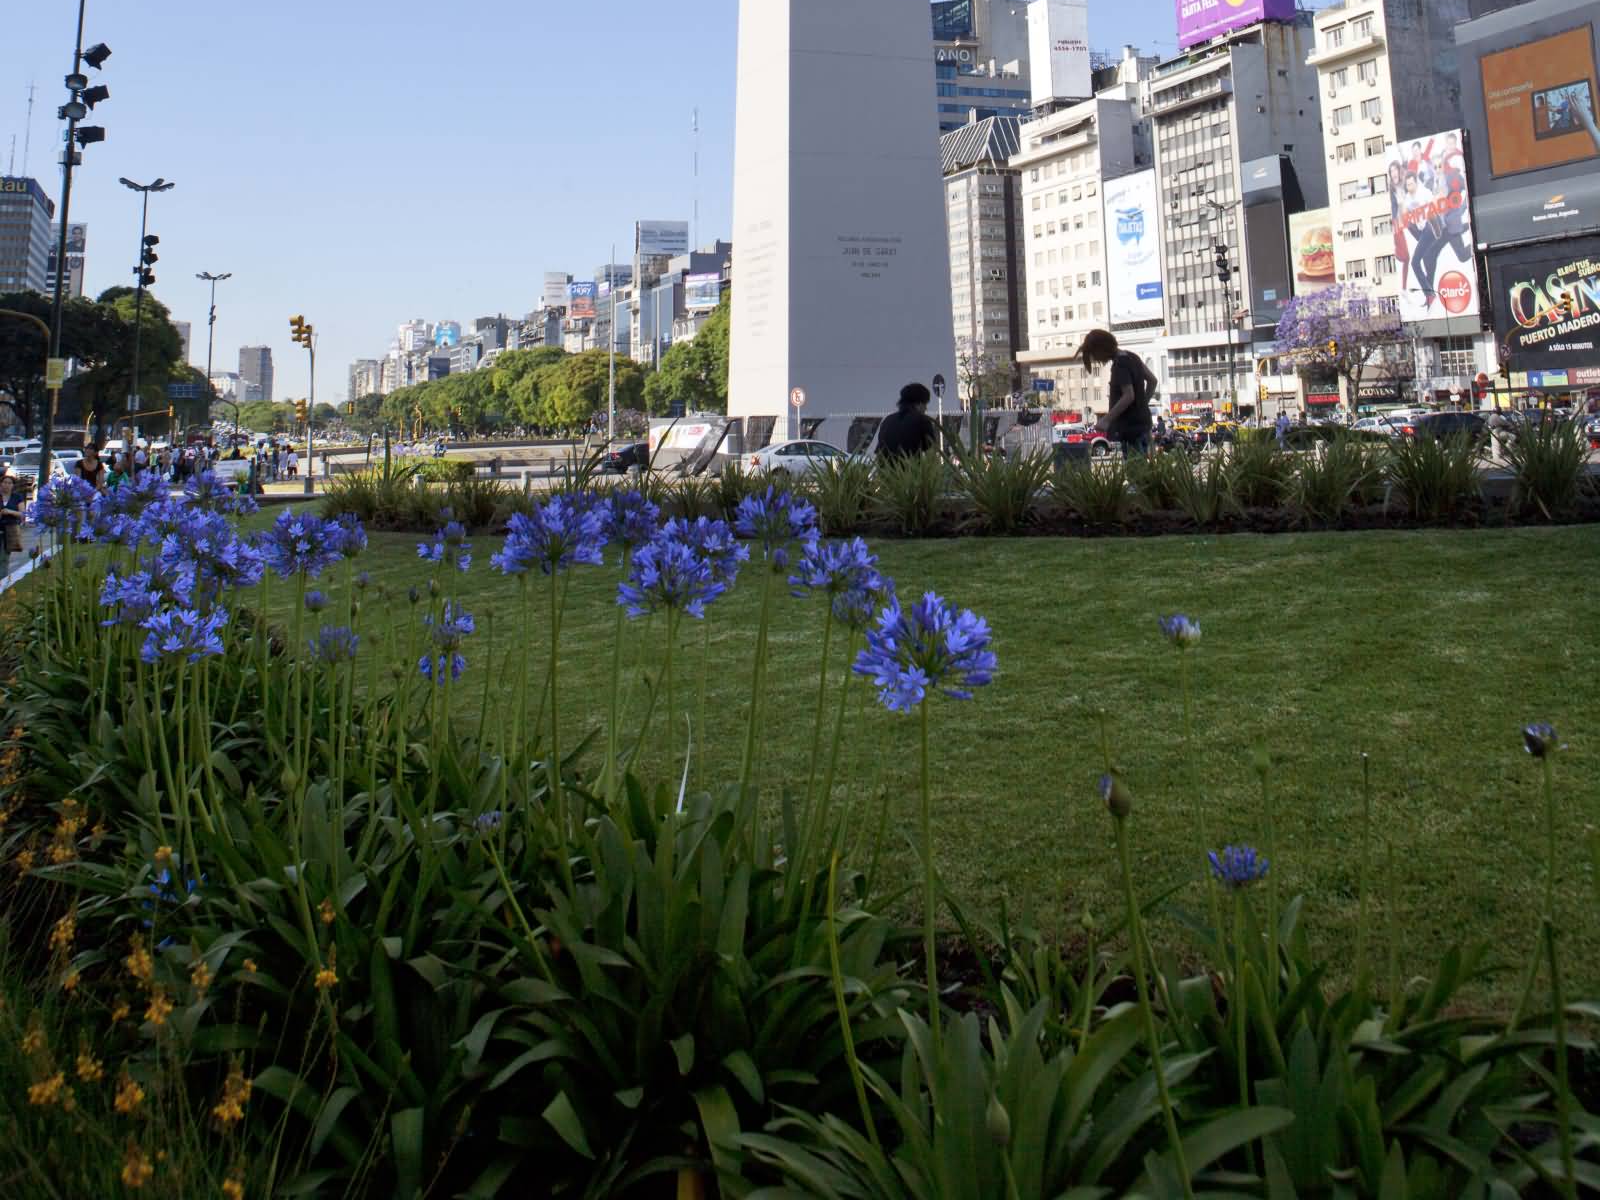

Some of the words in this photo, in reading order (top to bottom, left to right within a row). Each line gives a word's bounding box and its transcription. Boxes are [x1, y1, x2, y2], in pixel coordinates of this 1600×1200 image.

[1440, 287, 1465, 298] Claro
[1520, 326, 1556, 347] PUERTO
[1557, 313, 1600, 335] MADERO
